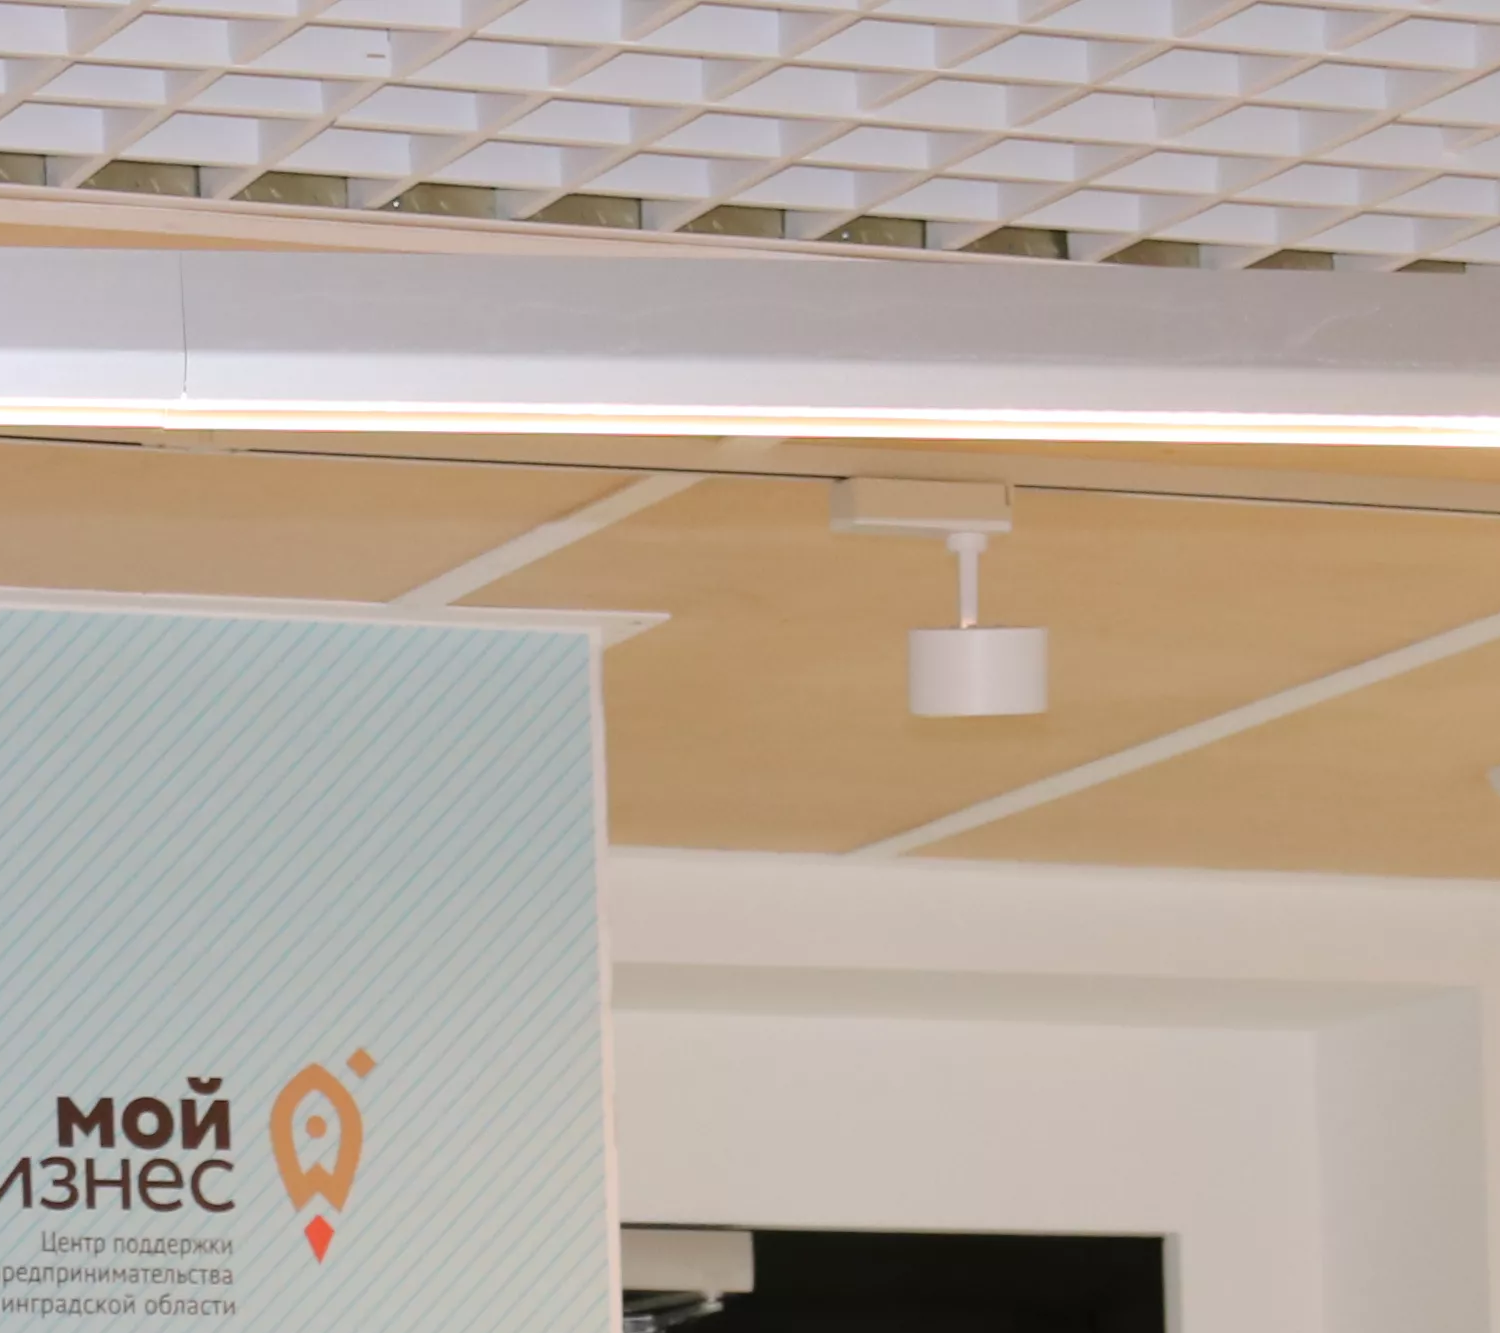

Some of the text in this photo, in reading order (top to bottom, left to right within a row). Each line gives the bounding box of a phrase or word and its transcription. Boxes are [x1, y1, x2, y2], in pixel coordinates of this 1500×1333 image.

[40, 1230, 233, 1258] Центр поддержки
[144, 1292, 236, 1317] области
